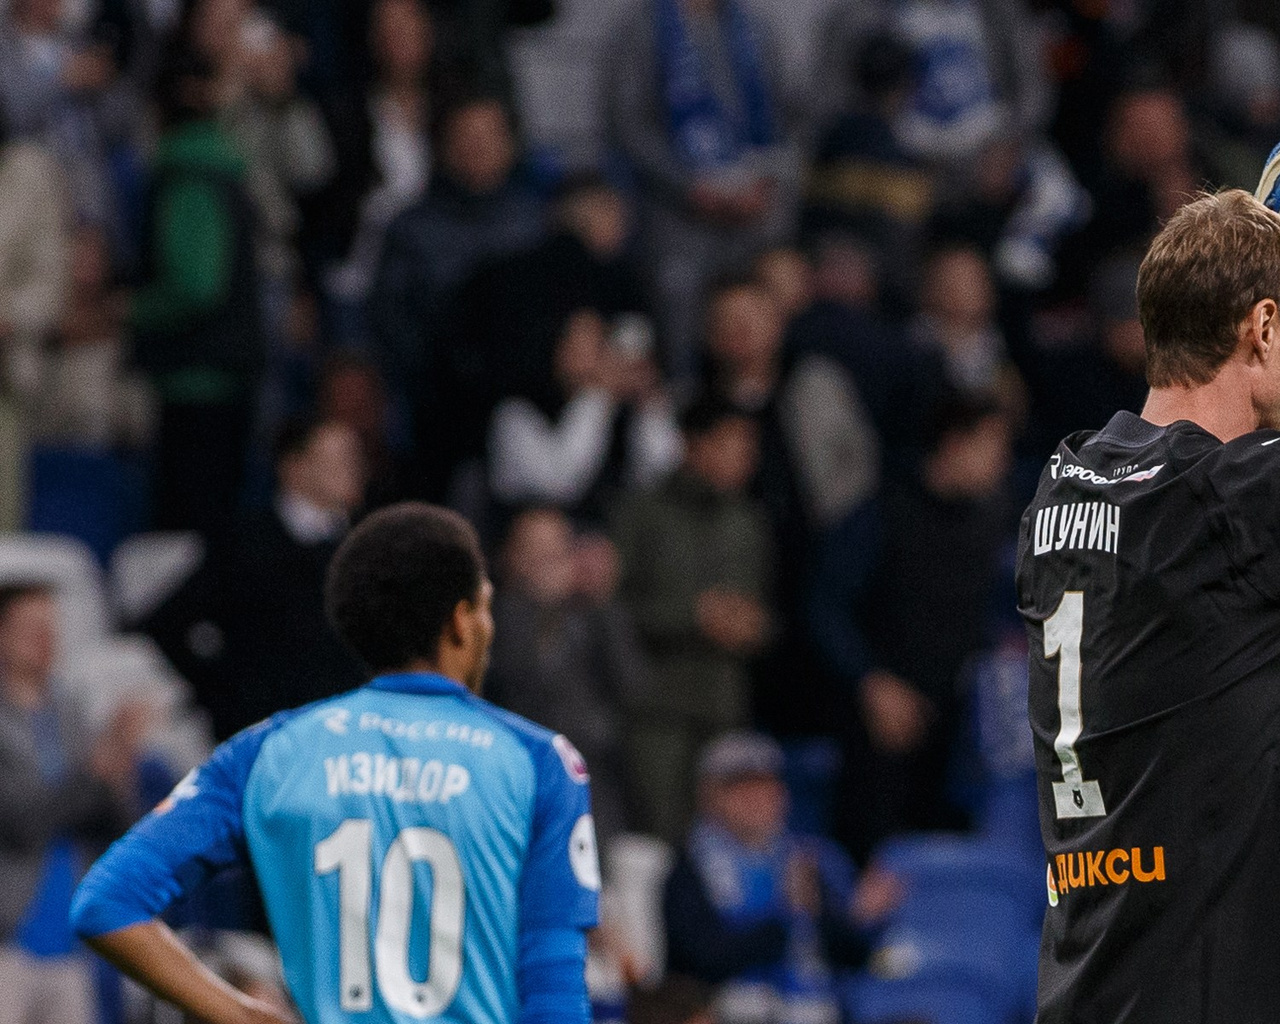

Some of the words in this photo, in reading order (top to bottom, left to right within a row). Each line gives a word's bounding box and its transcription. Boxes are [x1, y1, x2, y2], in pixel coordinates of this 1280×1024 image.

[1034, 502, 1120, 556] ШУНИН
[1043, 590, 1107, 819] 1
[324, 752, 470, 804] ИЗИДОР
[314, 818, 466, 1019] 10
